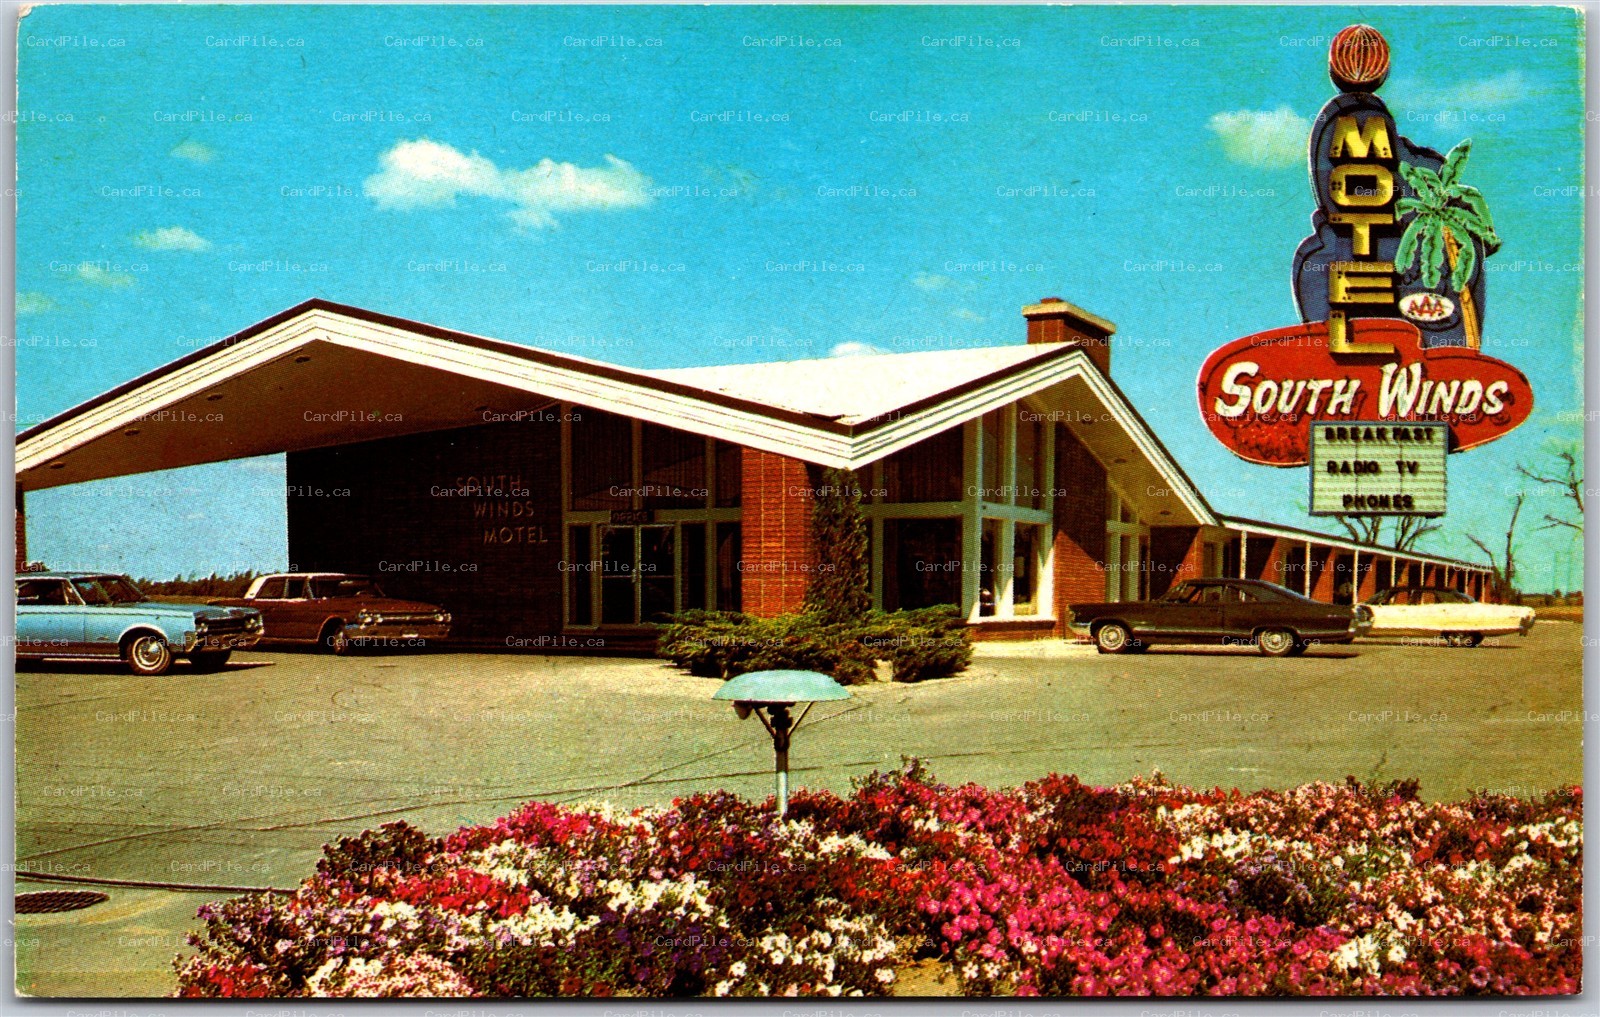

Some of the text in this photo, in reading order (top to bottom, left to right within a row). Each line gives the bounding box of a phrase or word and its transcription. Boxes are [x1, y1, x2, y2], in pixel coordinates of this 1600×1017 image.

[1329, 116, 1395, 354] MOTEL
[1406, 295, 1445, 317] AAA
[1213, 361, 1509, 420] SOUTH WINDS
[1327, 460, 1419, 475] RADIO TV
[455, 474, 521, 491] SOUTH
[473, 500, 535, 519] WINDS
[1342, 494, 1414, 510] PHONES
[483, 526, 549, 545] MOTEL
